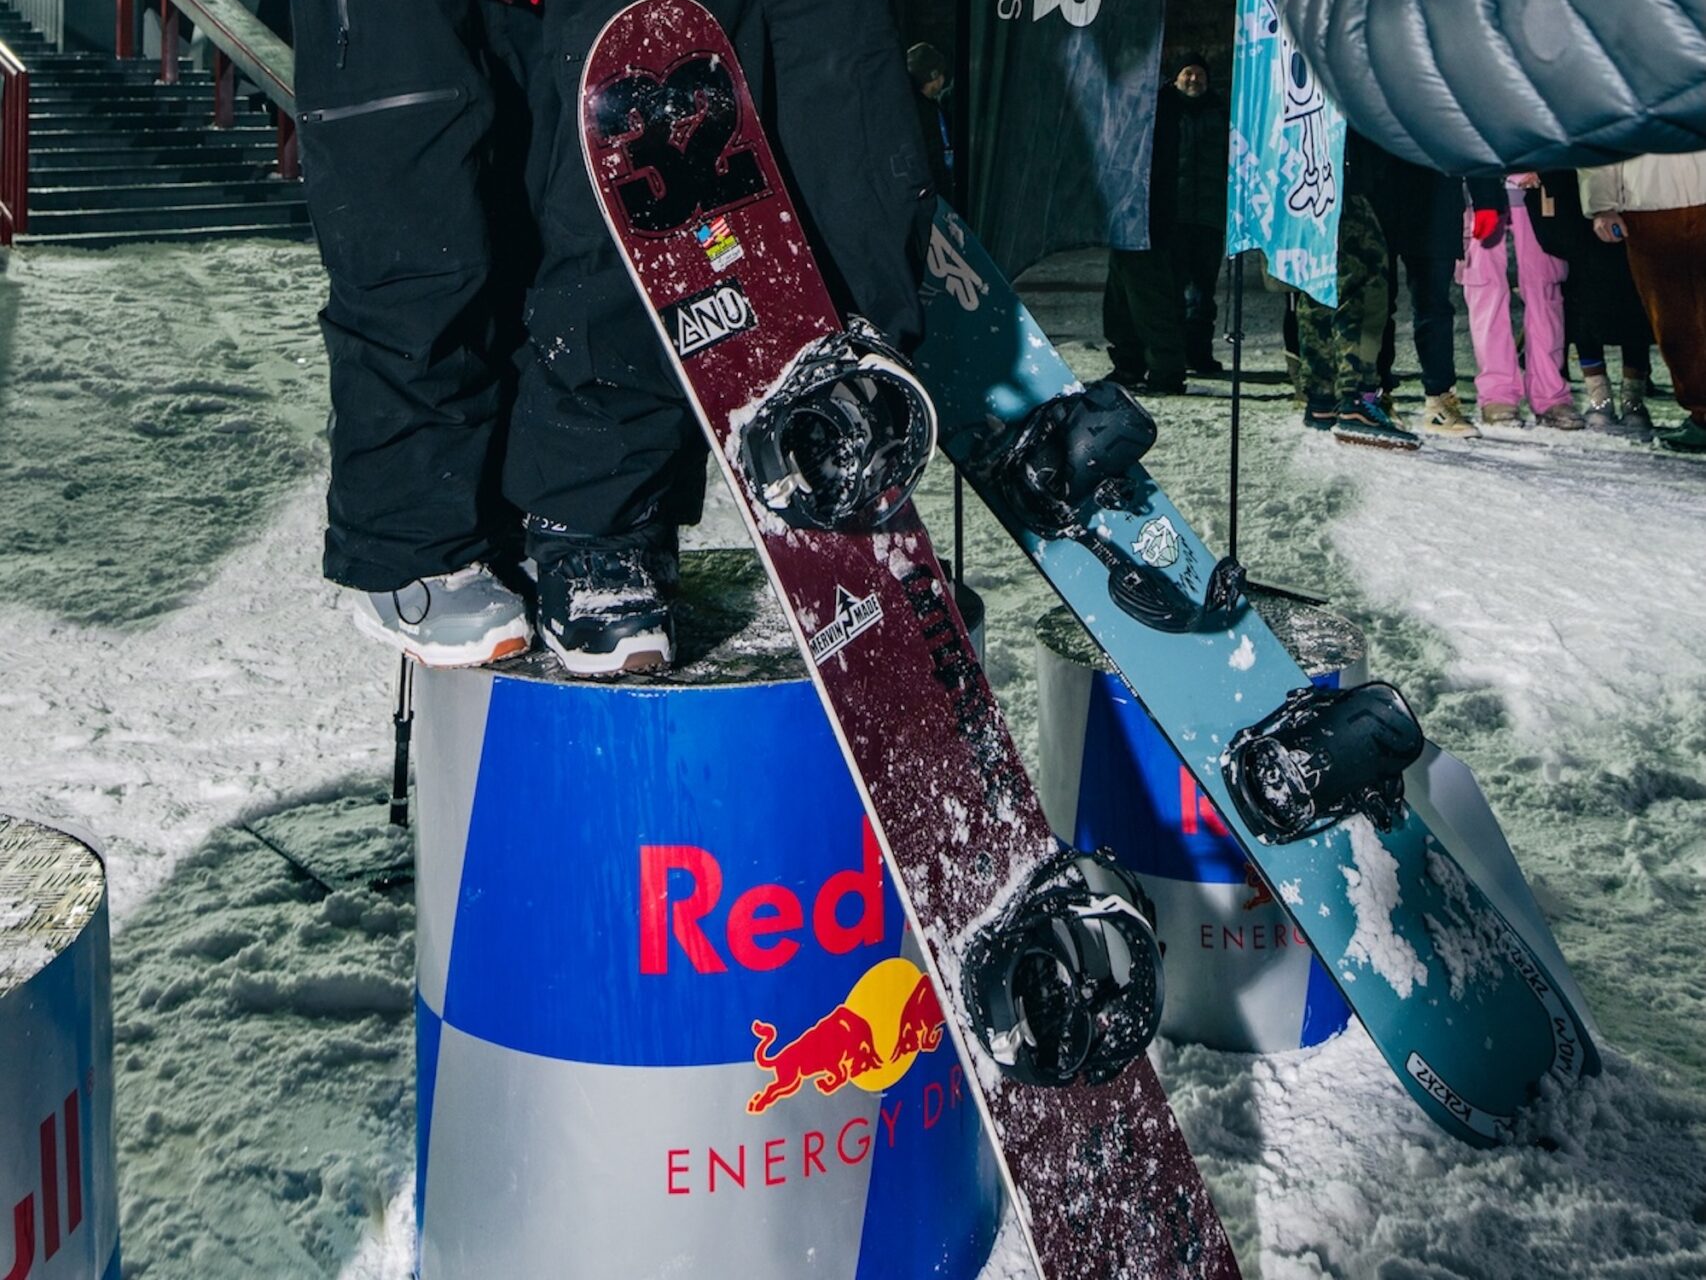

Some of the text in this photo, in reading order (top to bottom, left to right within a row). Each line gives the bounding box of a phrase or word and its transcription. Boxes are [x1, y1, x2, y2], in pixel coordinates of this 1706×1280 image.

[809, 596, 881, 657] MERVIN MADE
[638, 814, 888, 976] Red
[1200, 924, 1312, 951] ENERG
[667, 1100, 903, 1194] ENERGY
